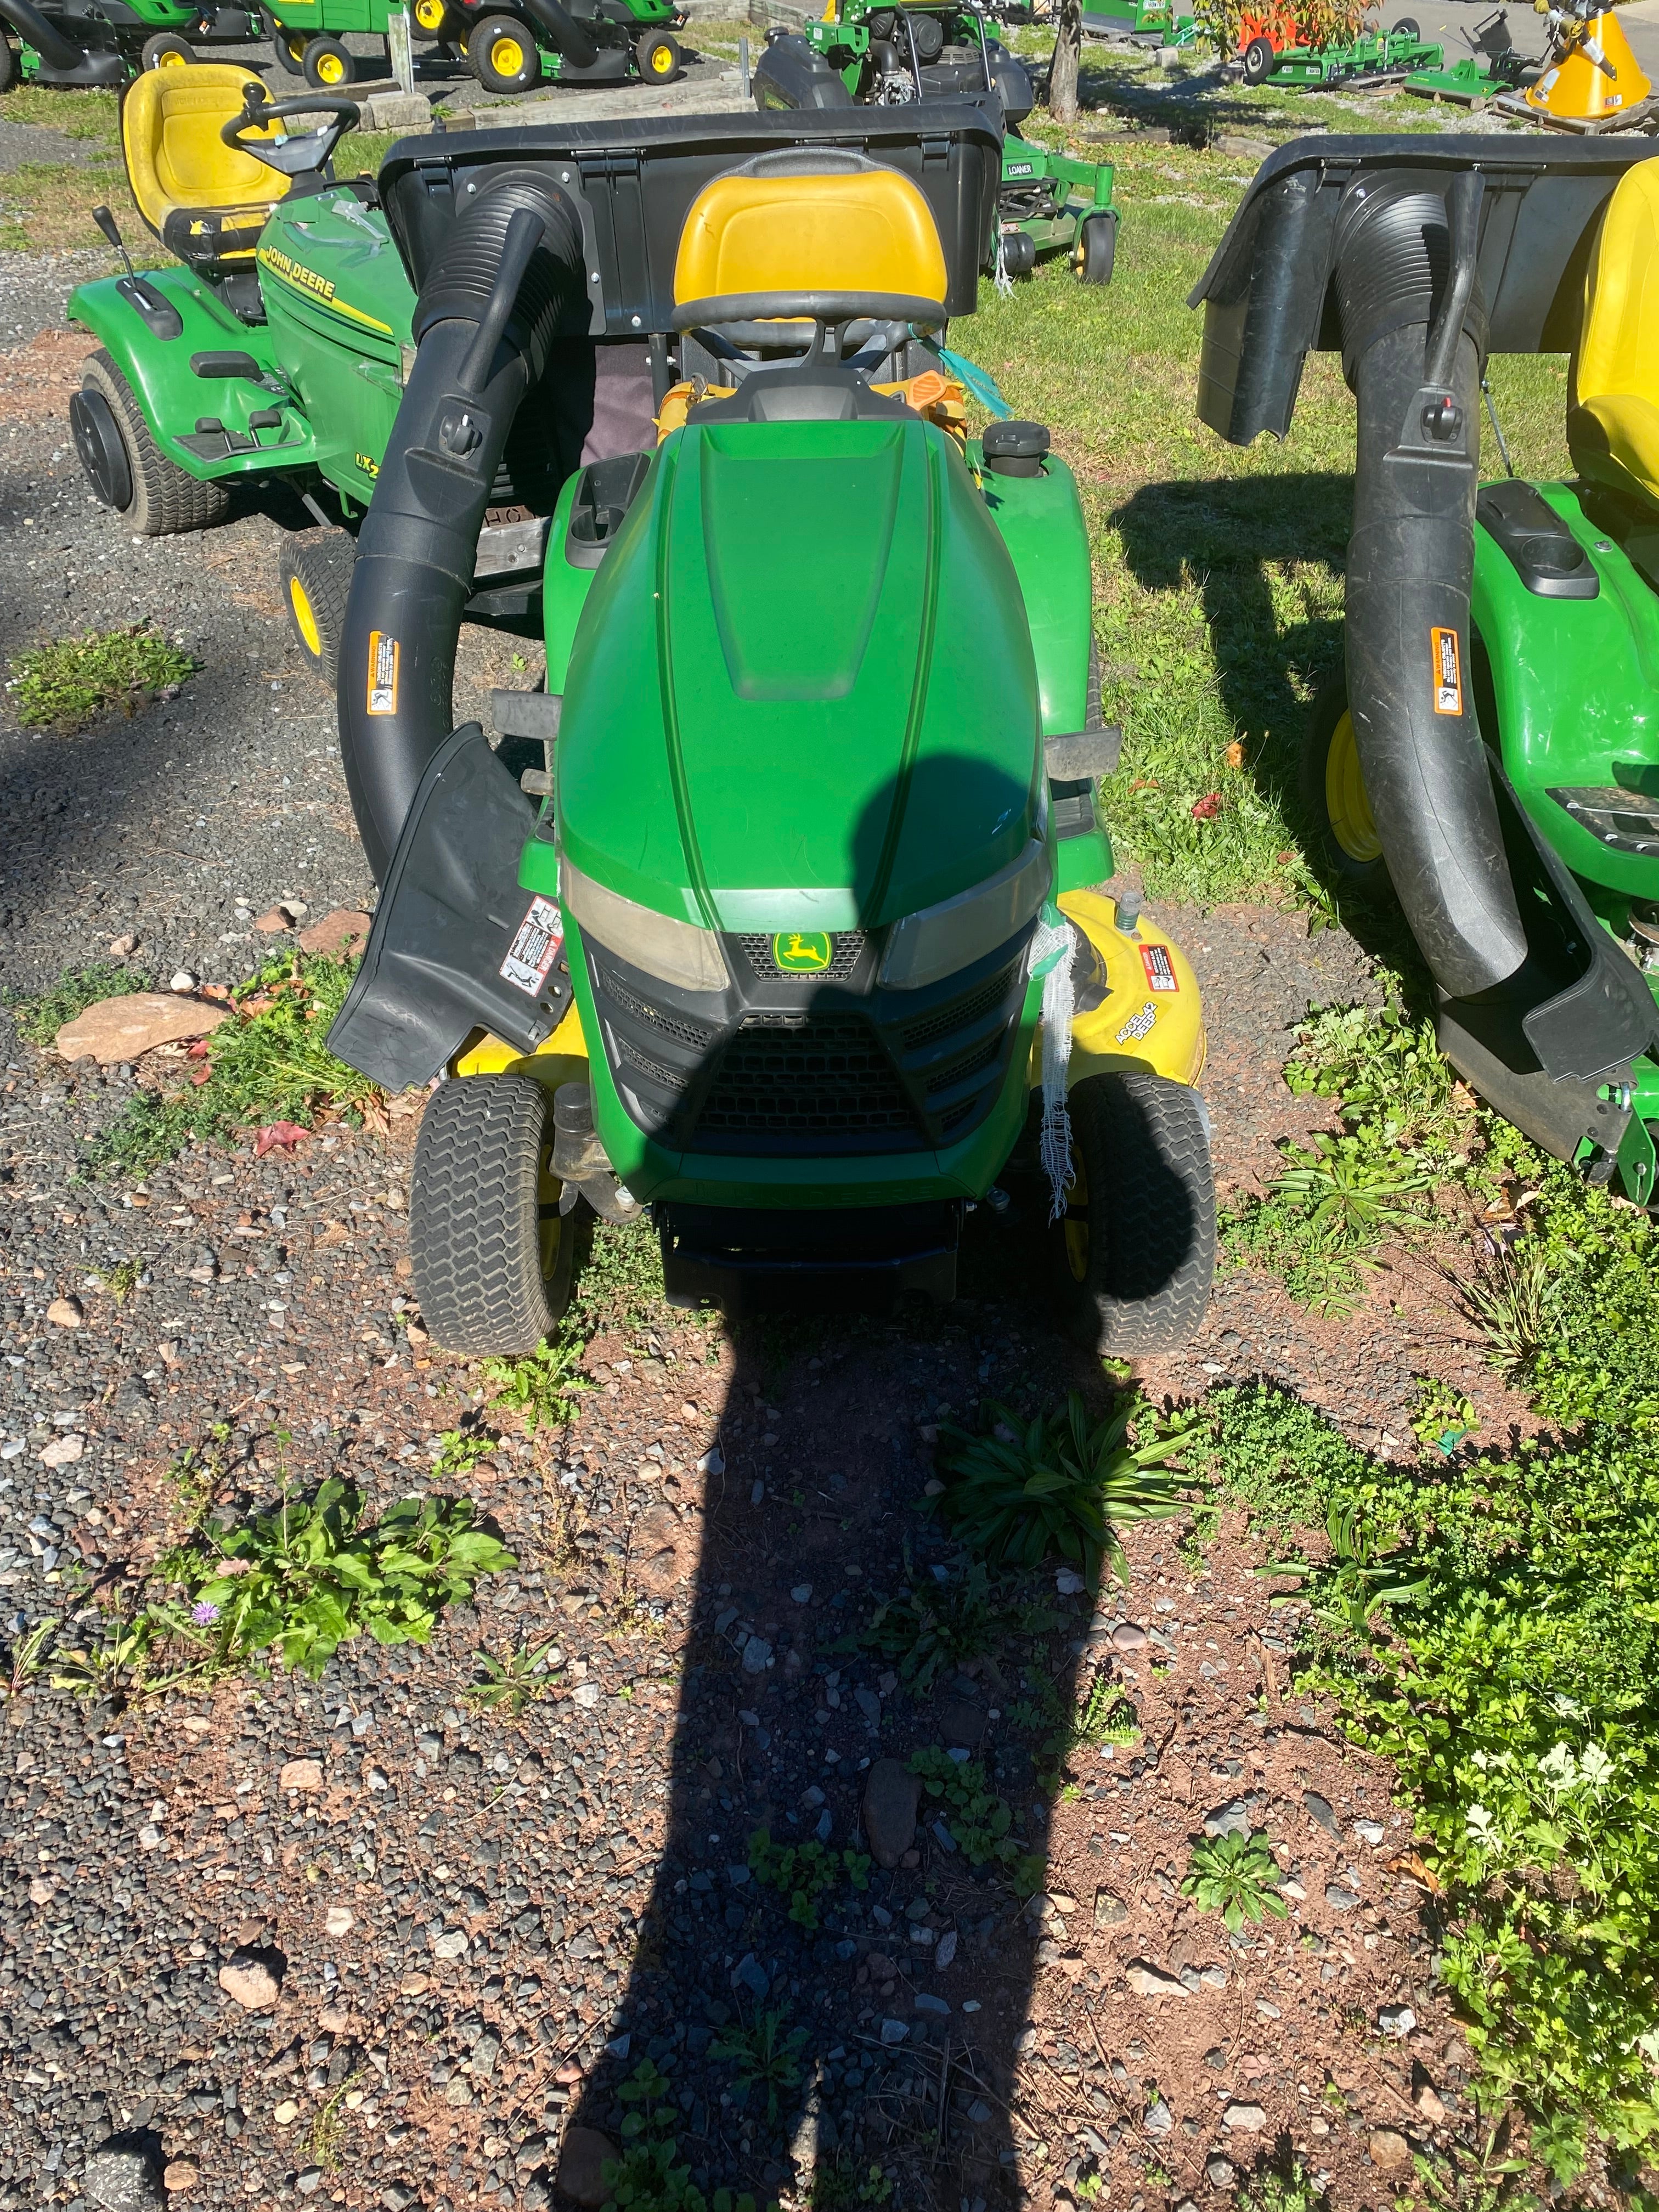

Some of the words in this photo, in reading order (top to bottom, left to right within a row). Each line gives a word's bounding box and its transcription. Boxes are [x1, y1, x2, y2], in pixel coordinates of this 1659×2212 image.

[1008, 165, 1031, 175] LOANER
[266, 245, 292, 275] JOHN
[292, 261, 335, 301] DEERE
[356, 452, 379, 481] LX2
[539, 947, 557, 971] DANGER
[1142, 952, 1150, 967] DANGER
[1131, 1012, 1156, 1041] DEEP
